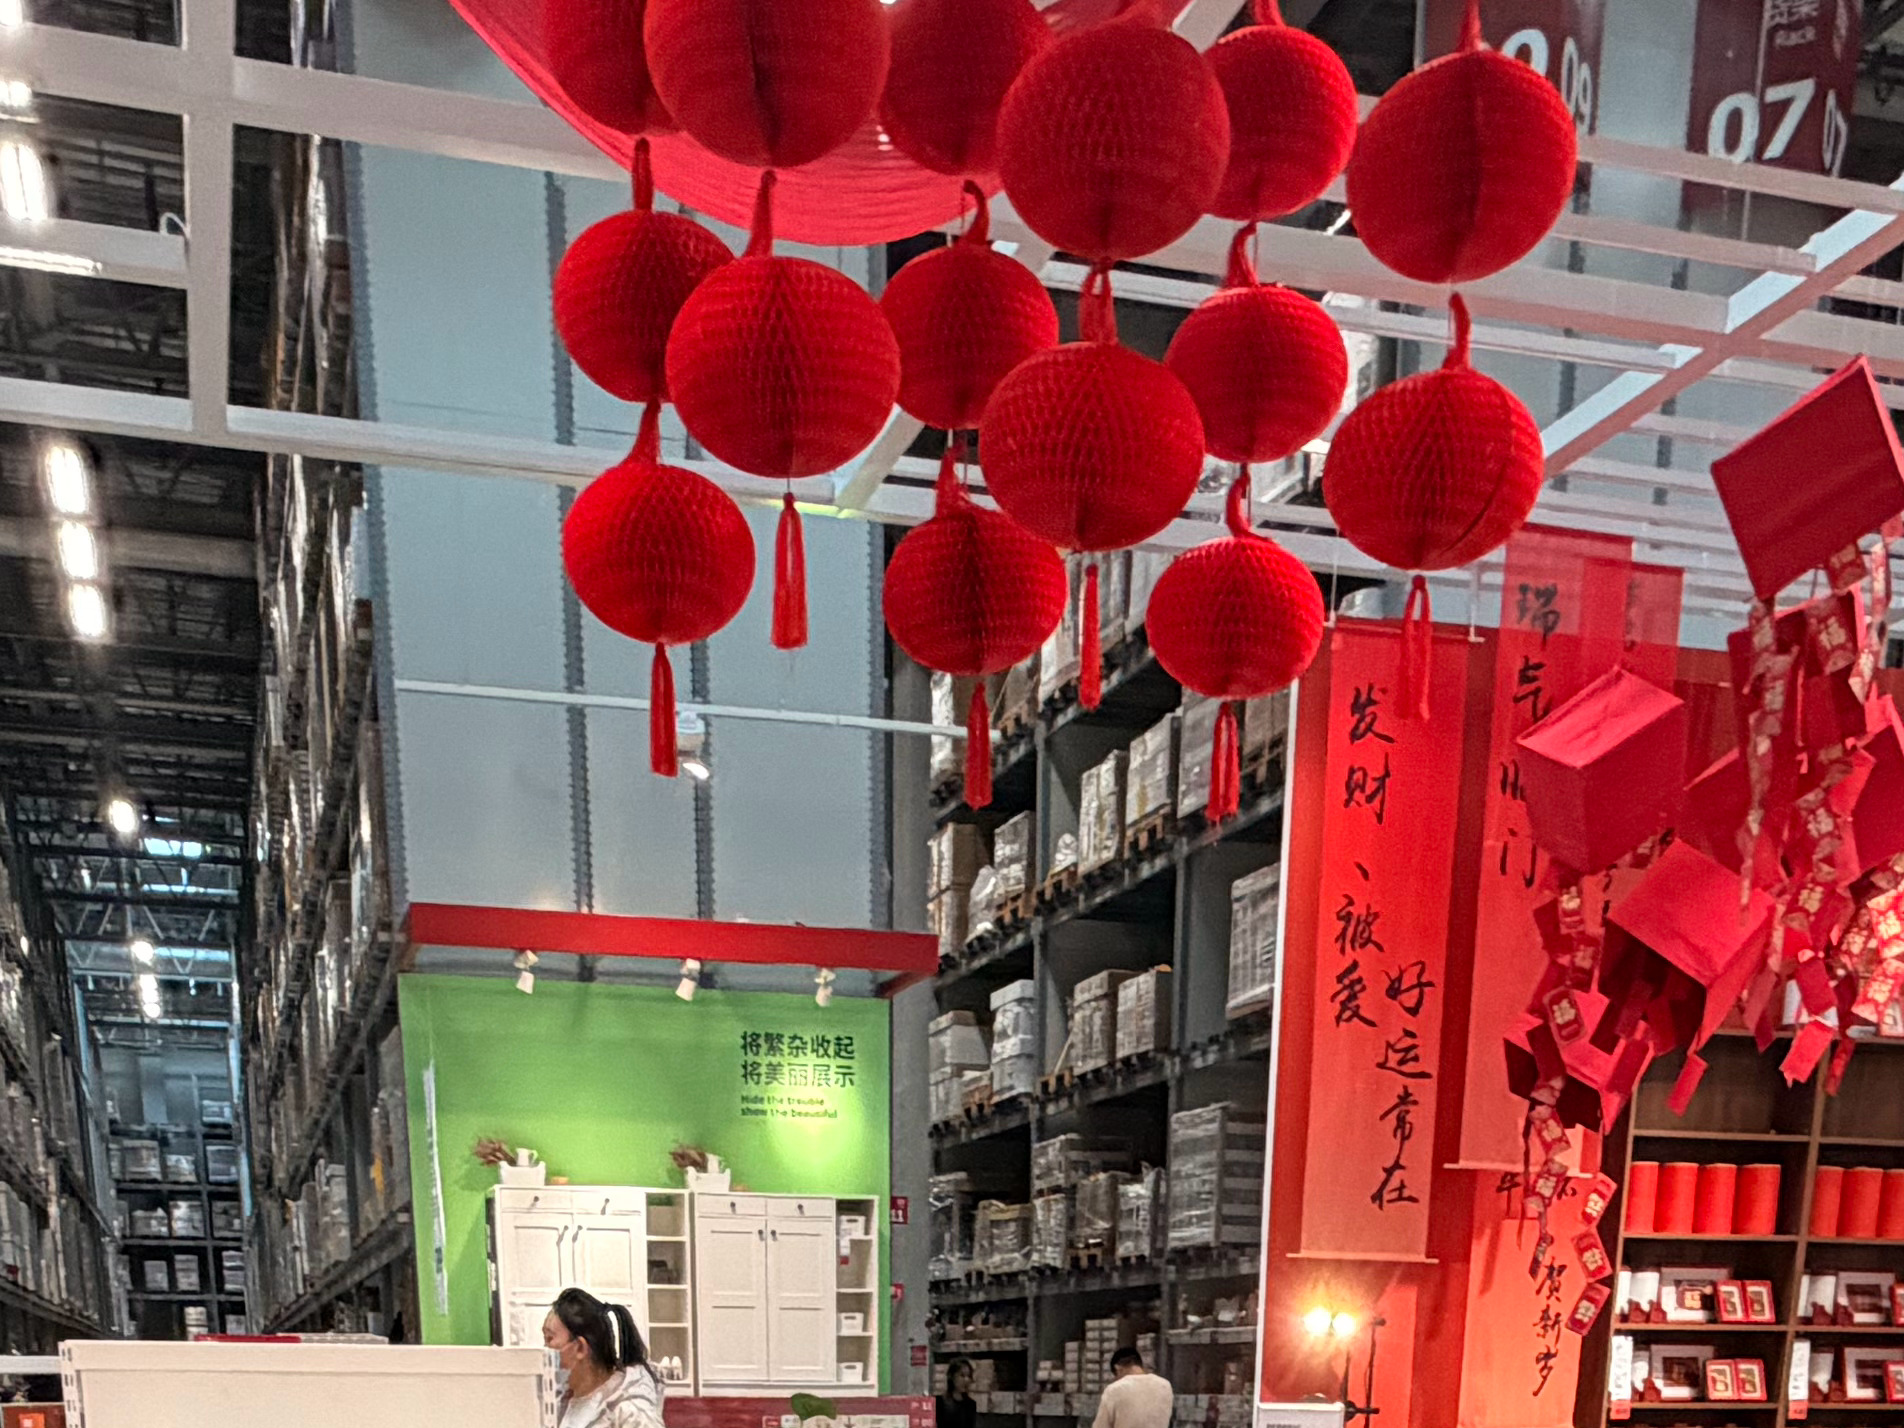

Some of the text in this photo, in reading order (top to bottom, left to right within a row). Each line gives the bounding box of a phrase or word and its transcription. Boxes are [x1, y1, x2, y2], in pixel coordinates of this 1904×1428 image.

[1708, 77, 1816, 164] 07
[740, 1031, 856, 1060] 将繁杂收起
[740, 1060, 856, 1088] 将美丽展示
[1370, 960, 1436, 1210] 好运常在
